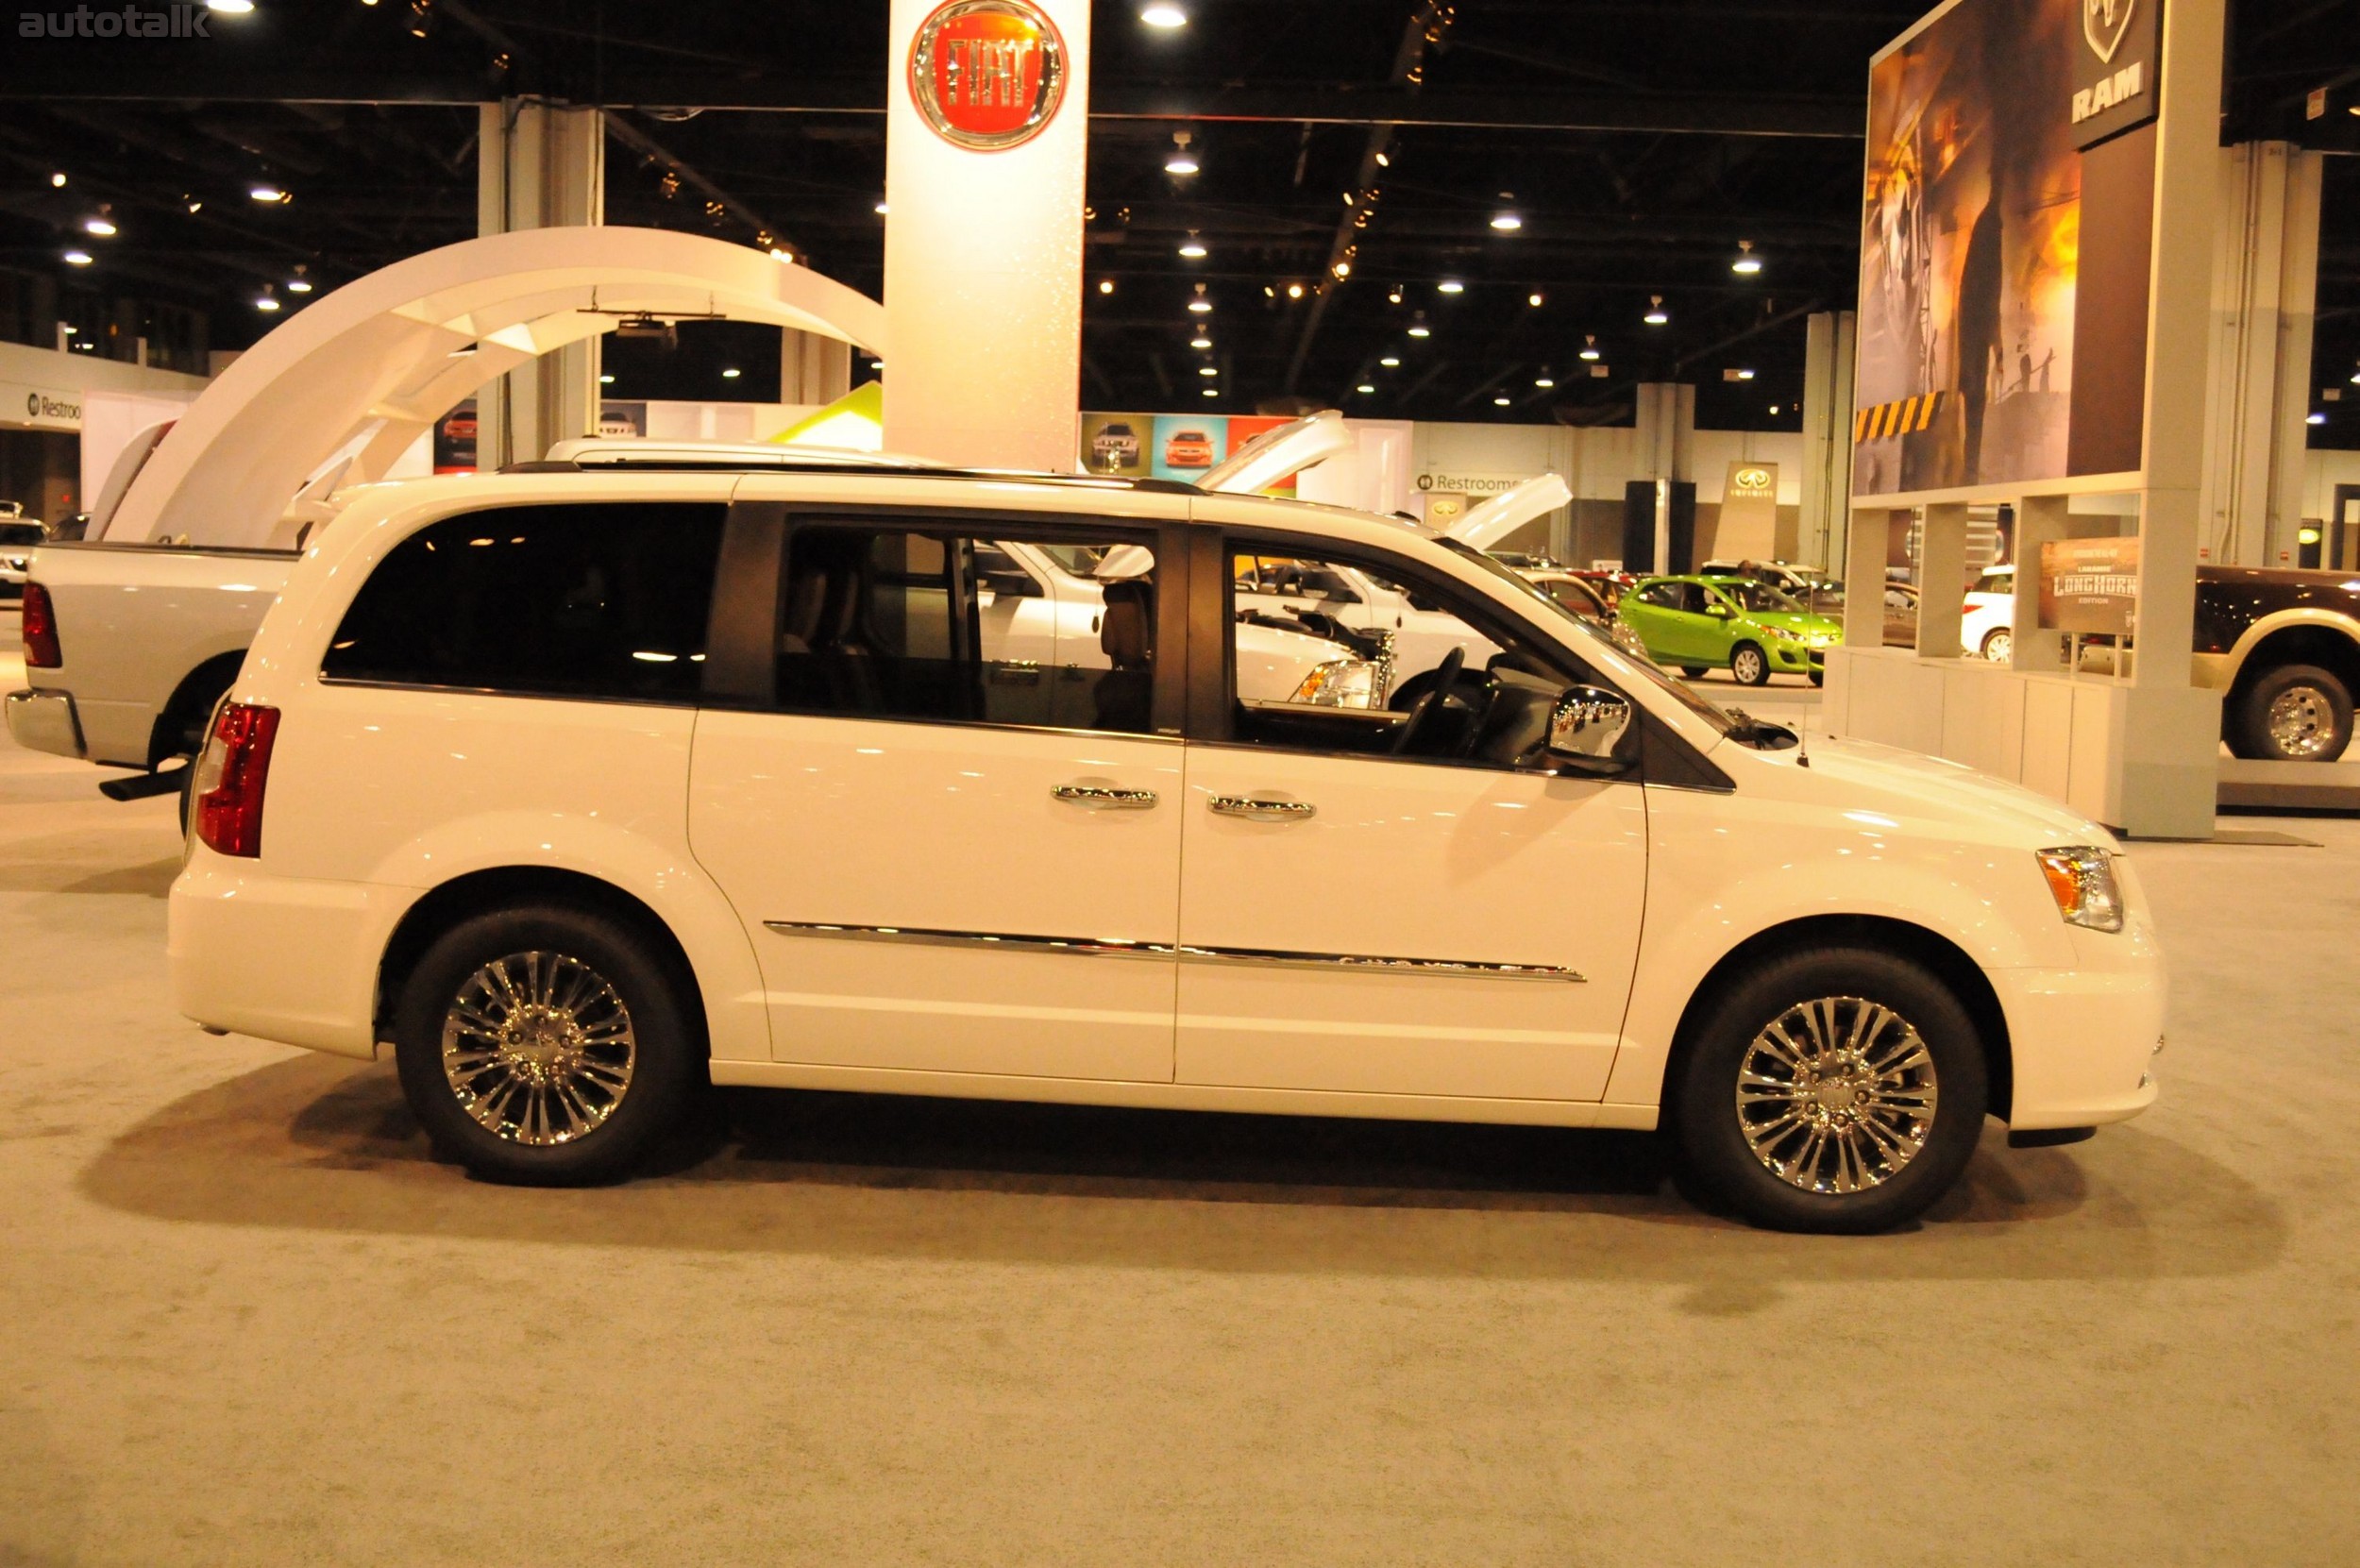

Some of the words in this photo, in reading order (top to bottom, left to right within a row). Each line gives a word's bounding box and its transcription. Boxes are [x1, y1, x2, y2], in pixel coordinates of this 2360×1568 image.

[948, 39, 1034, 108] FIAT
[2071, 60, 2143, 125] RAM
[42, 396, 82, 419] Restroo
